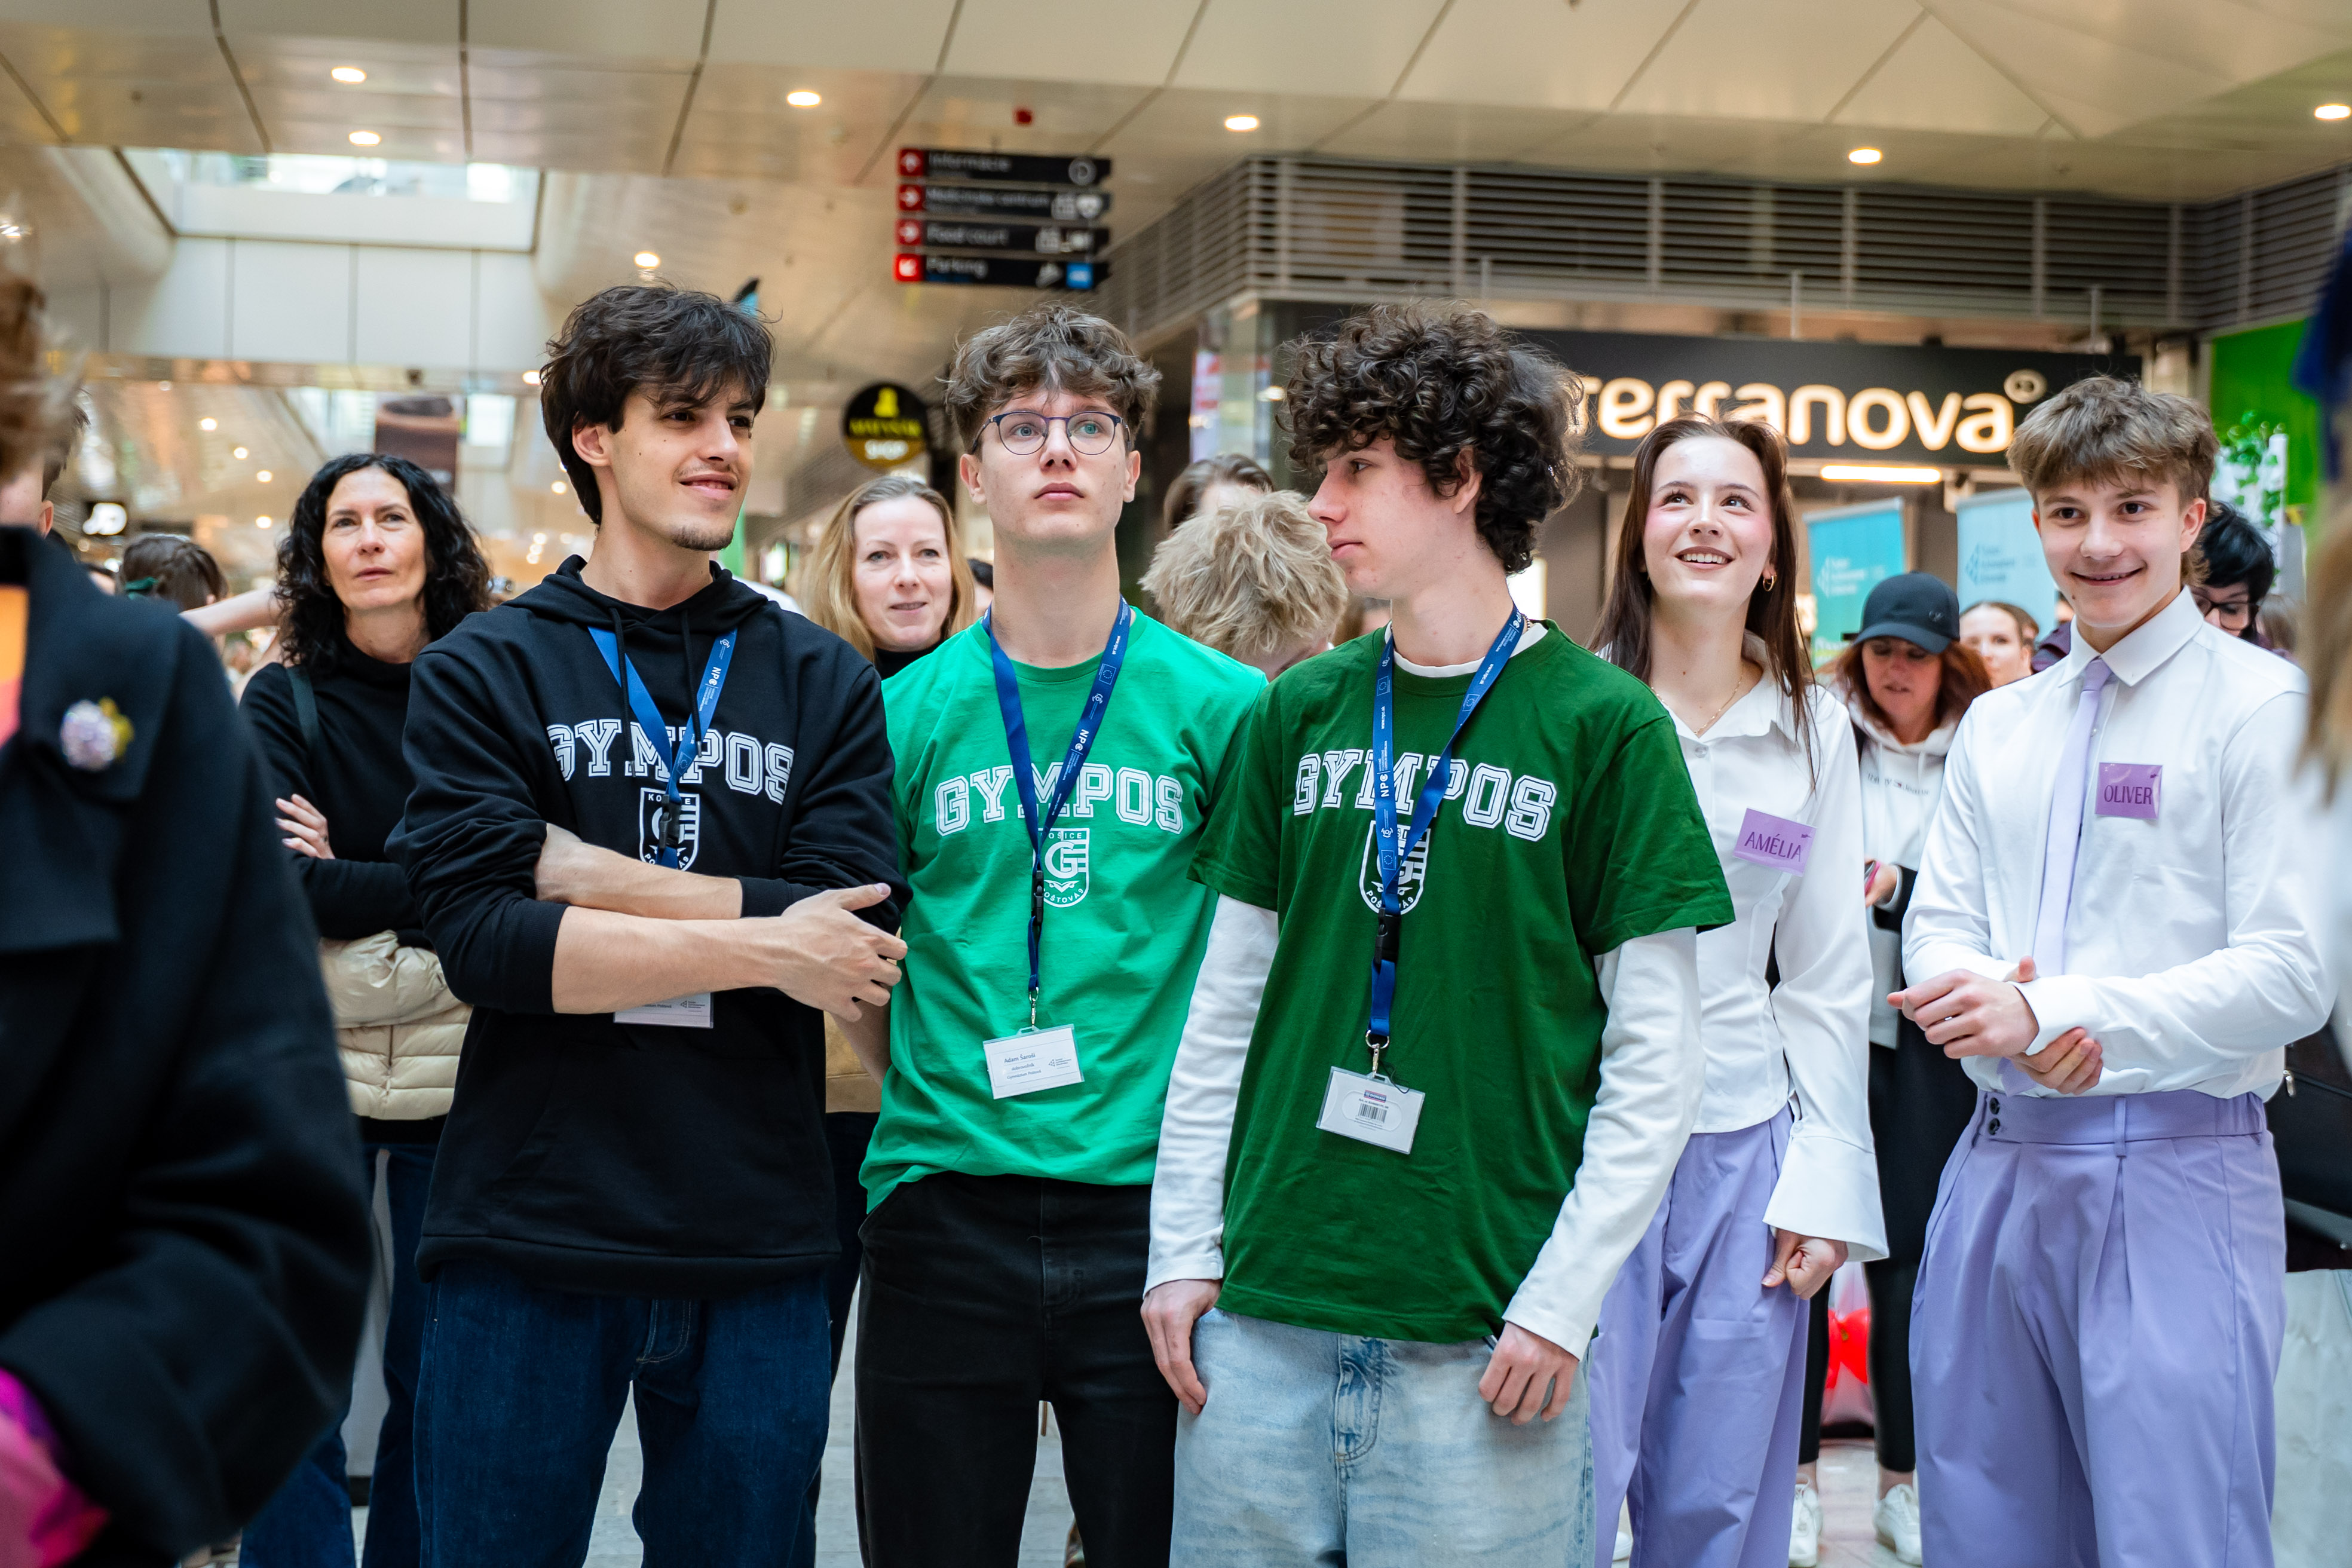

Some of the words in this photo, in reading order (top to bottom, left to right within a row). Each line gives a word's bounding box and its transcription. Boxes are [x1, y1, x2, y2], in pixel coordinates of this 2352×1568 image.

[1074, 729, 1089, 751] NPC
[1380, 774, 1390, 798] NPC
[2104, 785, 2152, 805] OLIVER
[1744, 831, 1802, 862] AMÉLIA
